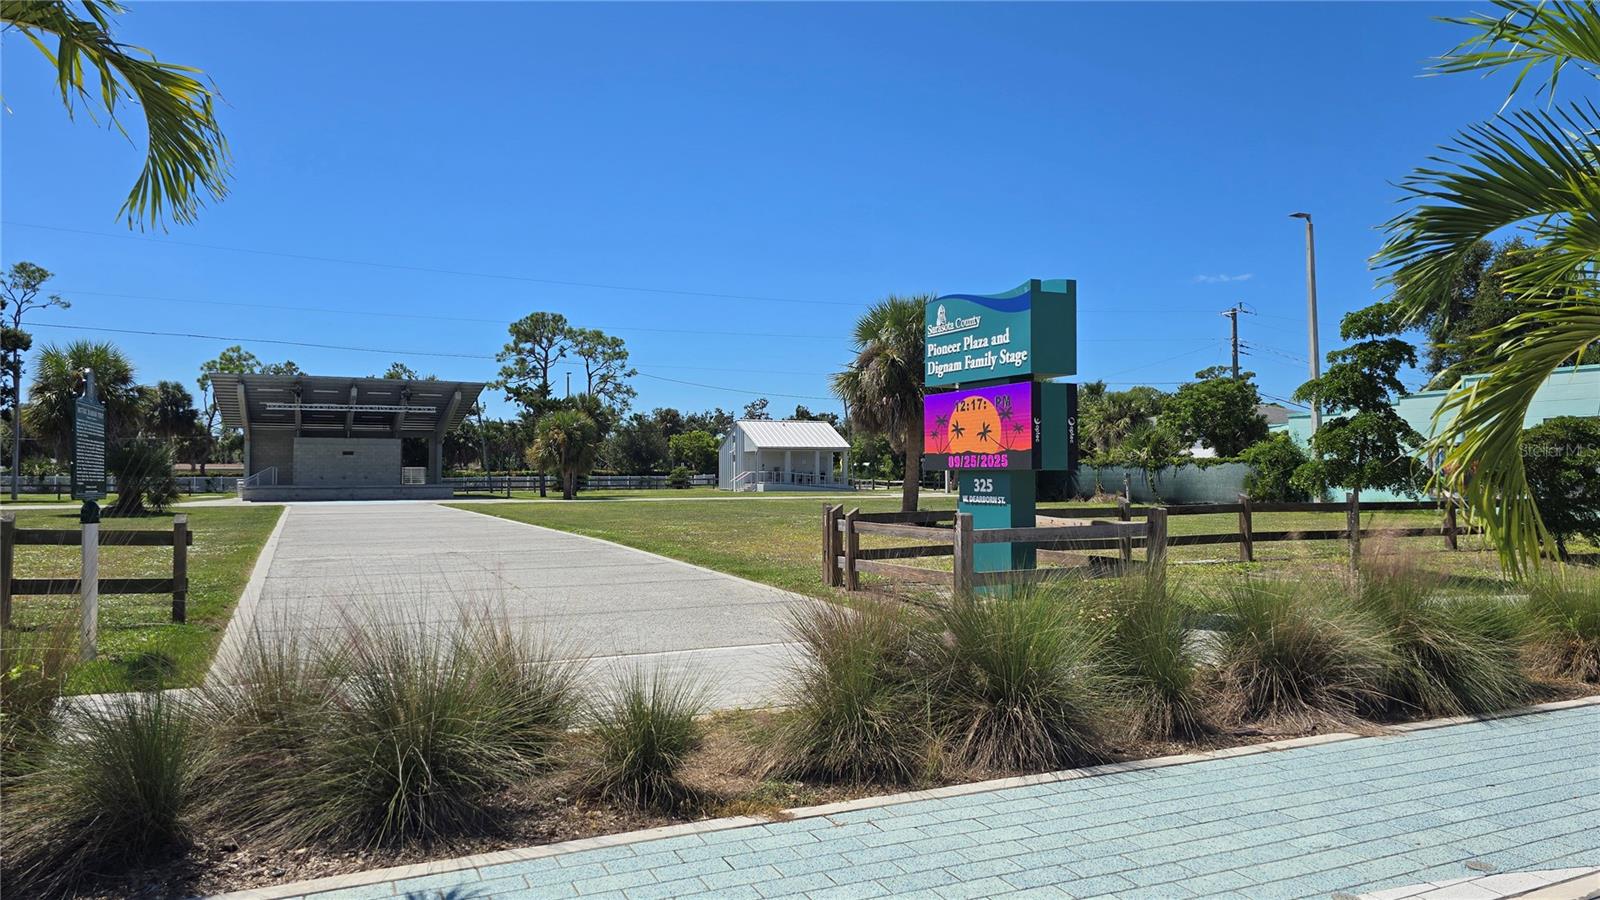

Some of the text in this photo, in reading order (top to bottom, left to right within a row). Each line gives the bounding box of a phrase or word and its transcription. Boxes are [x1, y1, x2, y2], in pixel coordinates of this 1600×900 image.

[927, 315, 981, 335] Sarasota County
[927, 327, 1010, 358] Pioneer Plaza and
[927, 348, 1028, 378] Dignam Family Stage
[948, 454, 1009, 468] 09/25/2025
[973, 478, 993, 492] 325
[969, 495, 997, 504] DEARBORN
